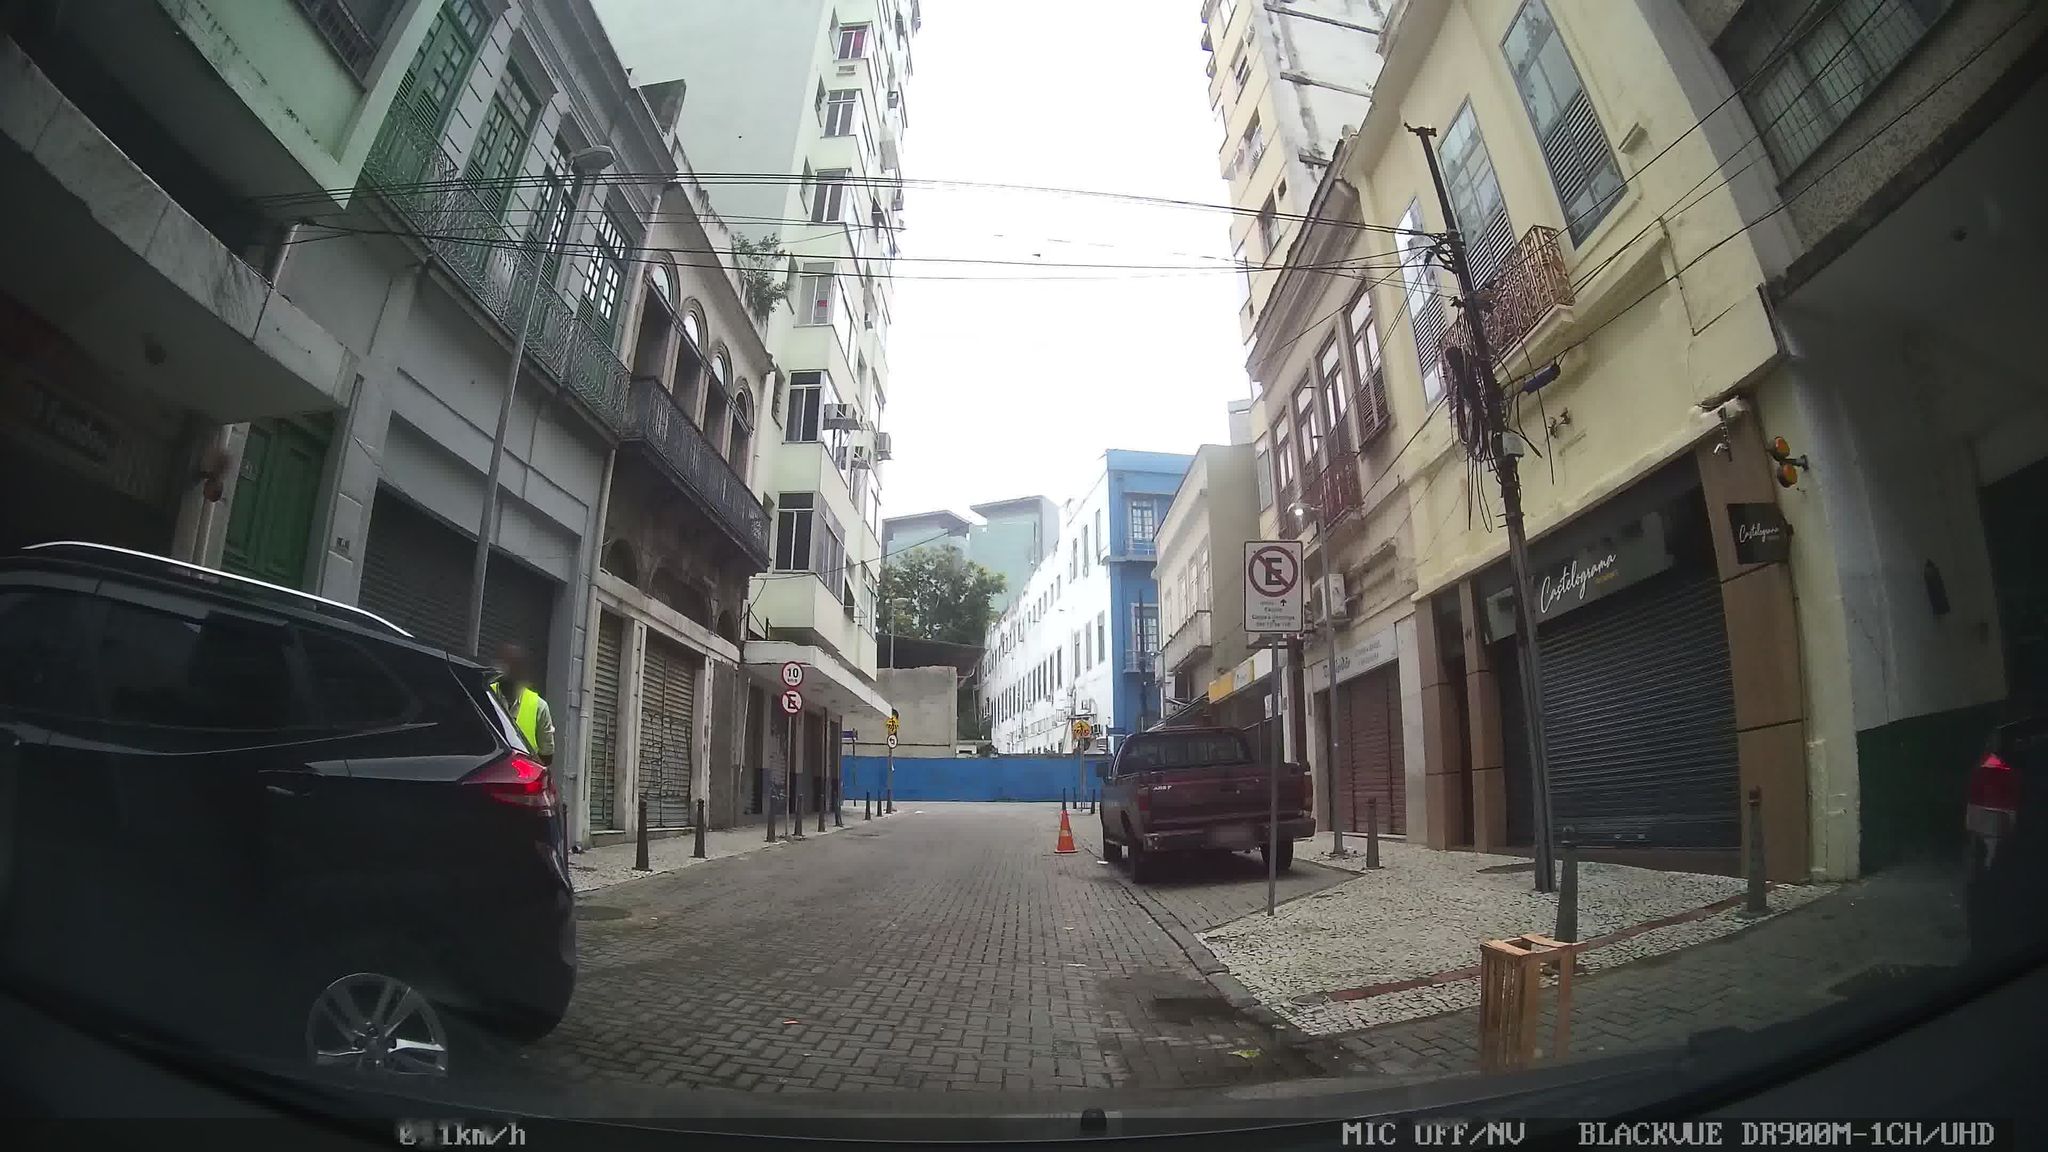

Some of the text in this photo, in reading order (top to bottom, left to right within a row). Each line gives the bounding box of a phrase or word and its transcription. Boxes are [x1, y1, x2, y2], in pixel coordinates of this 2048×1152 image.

[1265, 557, 1282, 586] E
[1540, 553, 1617, 614] Castelograma
[787, 668, 799, 678] 10
